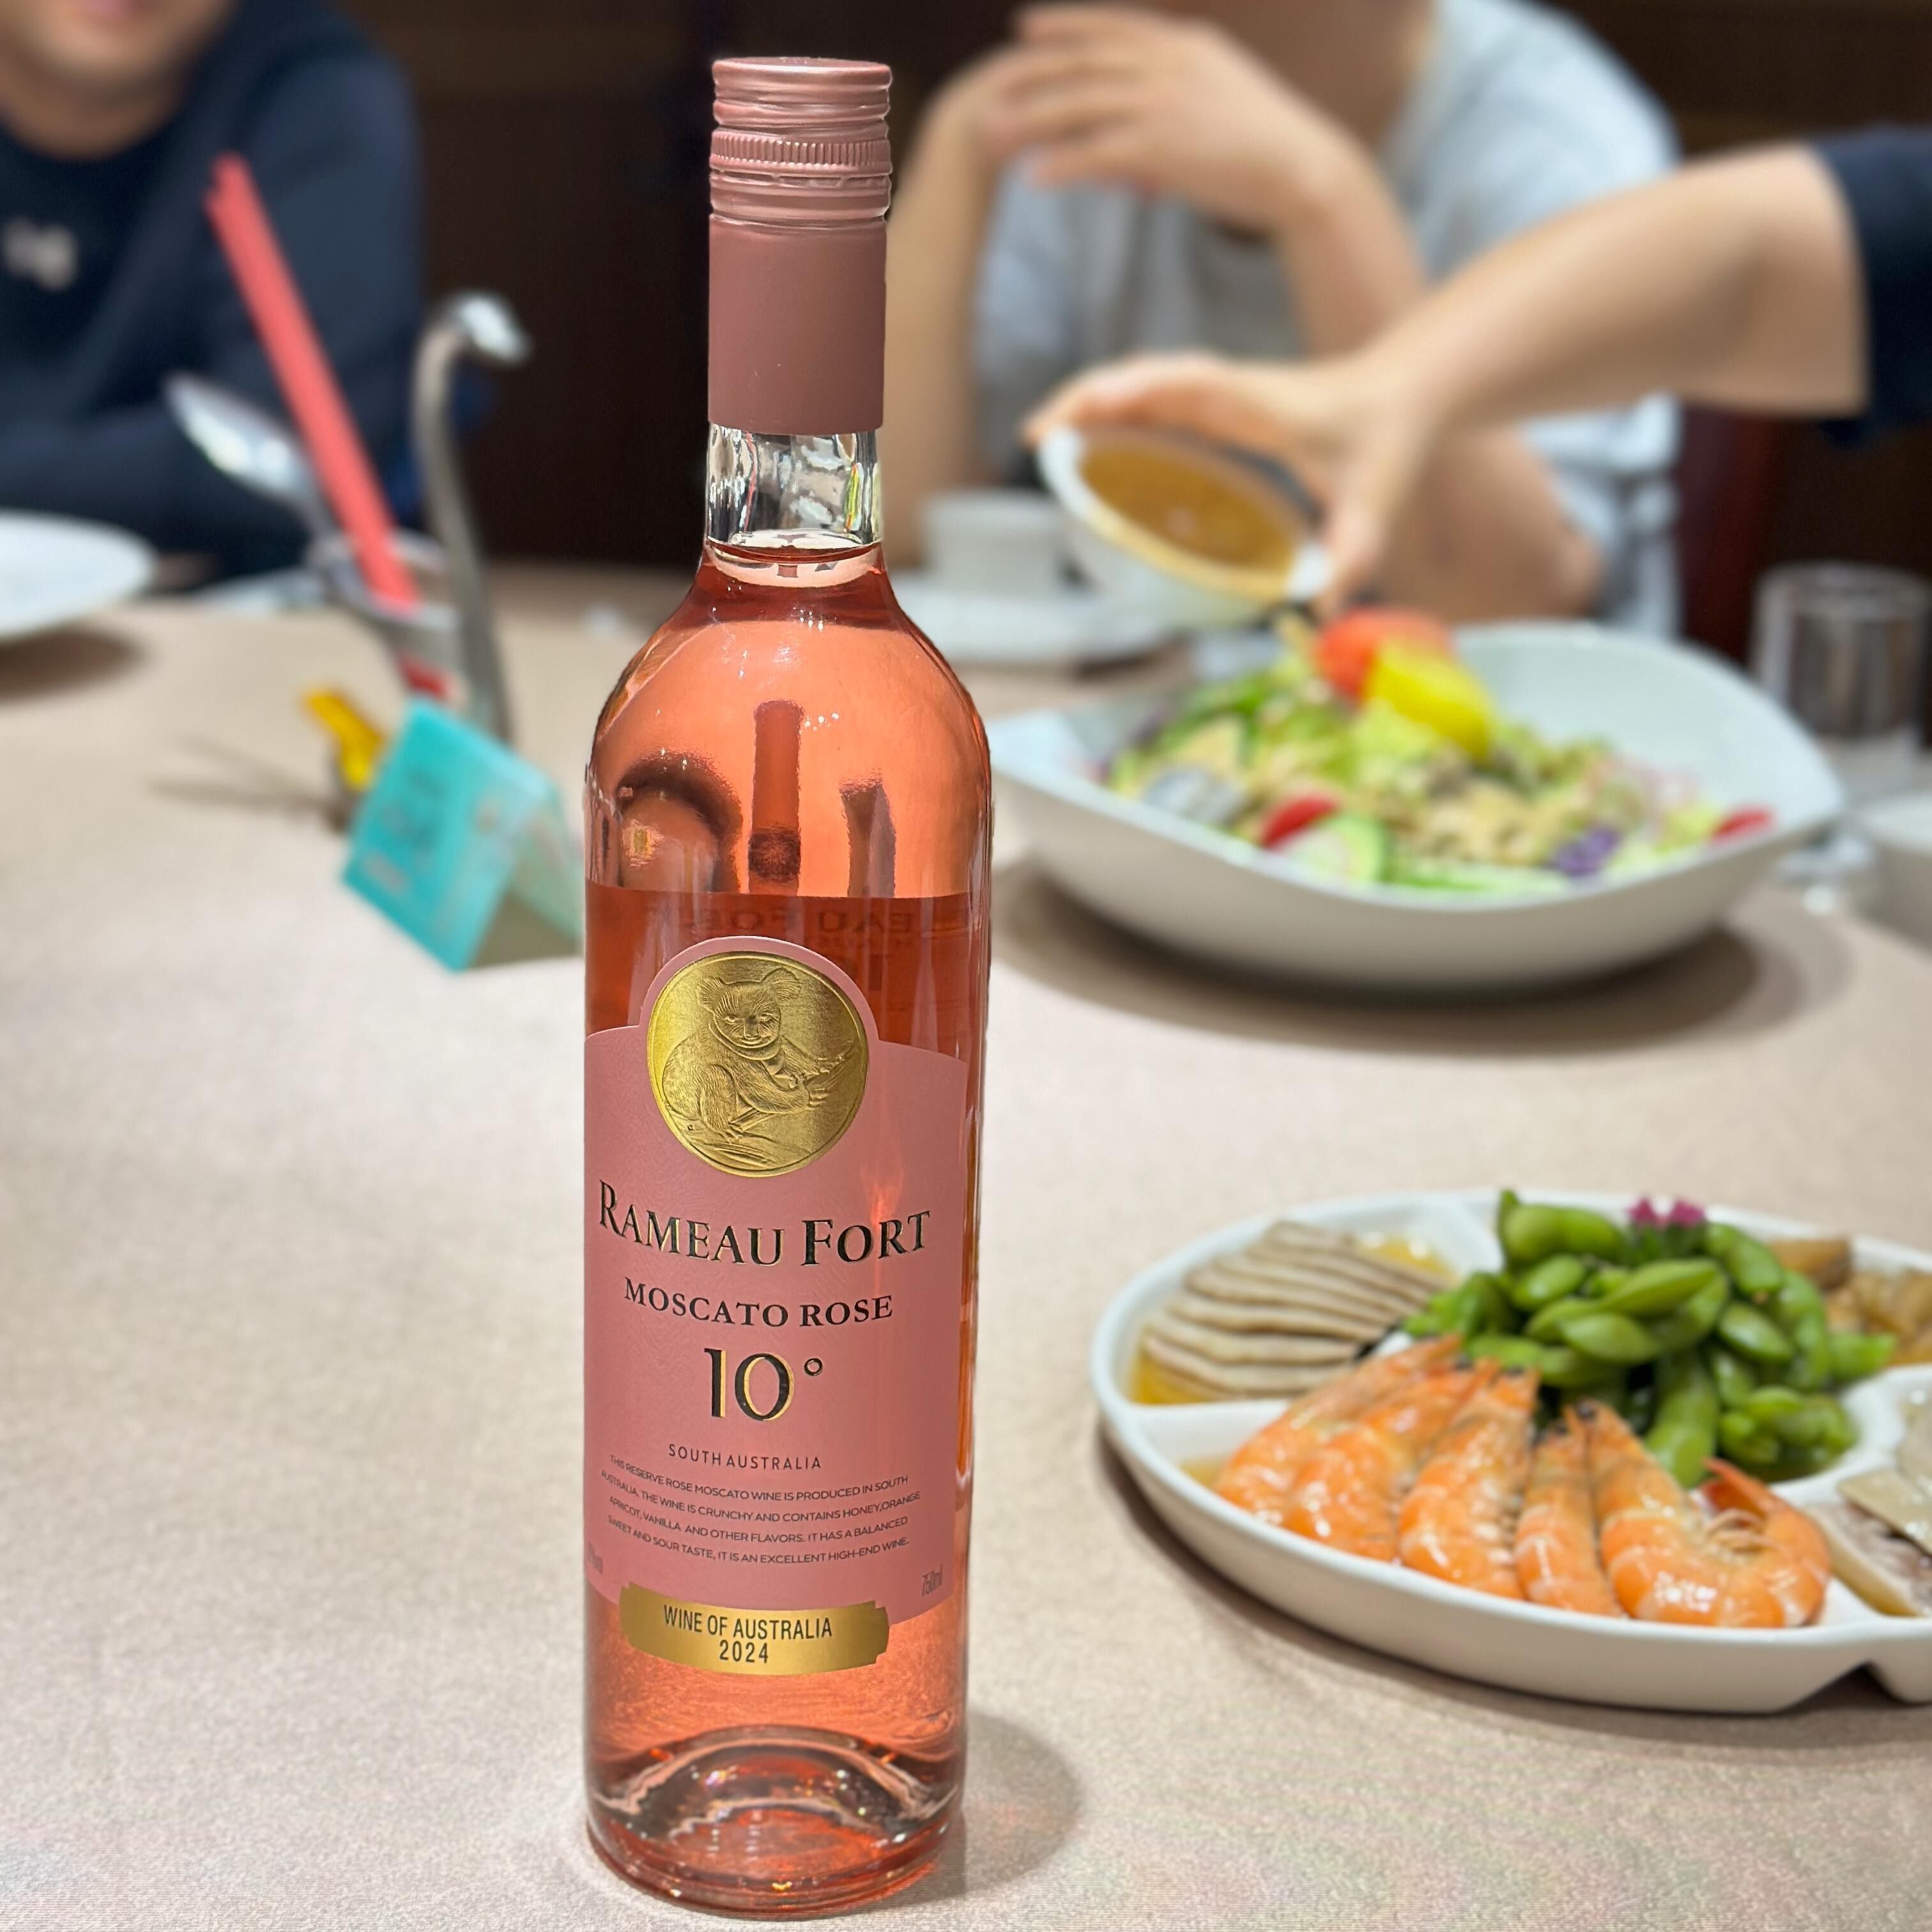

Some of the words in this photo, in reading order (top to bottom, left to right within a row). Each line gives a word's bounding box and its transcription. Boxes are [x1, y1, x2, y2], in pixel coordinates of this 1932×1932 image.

[599, 1179, 785, 1266] RAMEAU
[801, 1211, 930, 1266] FORT
[624, 1276, 788, 1327] MOSCATO
[799, 1295, 893, 1327] ROSE
[610, 1454, 624, 1469] THIS
[625, 1463, 664, 1484] RESERVE
[666, 1478, 693, 1492] ROSE
[695, 1485, 749, 1499] MOSCATO
[751, 1491, 781, 1501] WINE
[785, 1492, 793, 1501] IS
[797, 1487, 860, 1500] PRODUCED
[862, 1484, 873, 1494] IN
[875, 1475, 908, 1491] SOUTH
[641, 1490, 658, 1504] THE
[659, 1496, 685, 1511] WINE
[687, 1505, 696, 1514] IS
[698, 1506, 753, 1521] CRUNCHY
[755, 1512, 780, 1522] AND
[783, 1510, 840, 1522] CONTAINS
[608, 1515, 631, 1534] SWEET
[633, 1529, 651, 1543] AND
[653, 1536, 679, 1551] SOUR
[681, 1544, 716, 1560] TASTE,
[718, 1551, 727, 1560] IT
[730, 1552, 739, 1561] IS
[741, 1554, 758, 1563] AN
[760, 1553, 826, 1563] EXCELLENT
[829, 1544, 880, 1561] HIGH-END
[643, 1512, 681, 1531] VANILLA
[685, 1524, 709, 1537] AND
[710, 1529, 748, 1542] OTHER
[751, 1533, 805, 1543] FLAVORS.
[808, 1533, 817, 1542] IT
[820, 1530, 842, 1541] HAS
[843, 1530, 852, 1538] A
[854, 1516, 908, 1537] BALANCED
[664, 1604, 702, 1633] WINE
[707, 1614, 728, 1636] OF
[733, 1617, 832, 1640] AUSTRALIA
[719, 1639, 768, 1664] 2024
